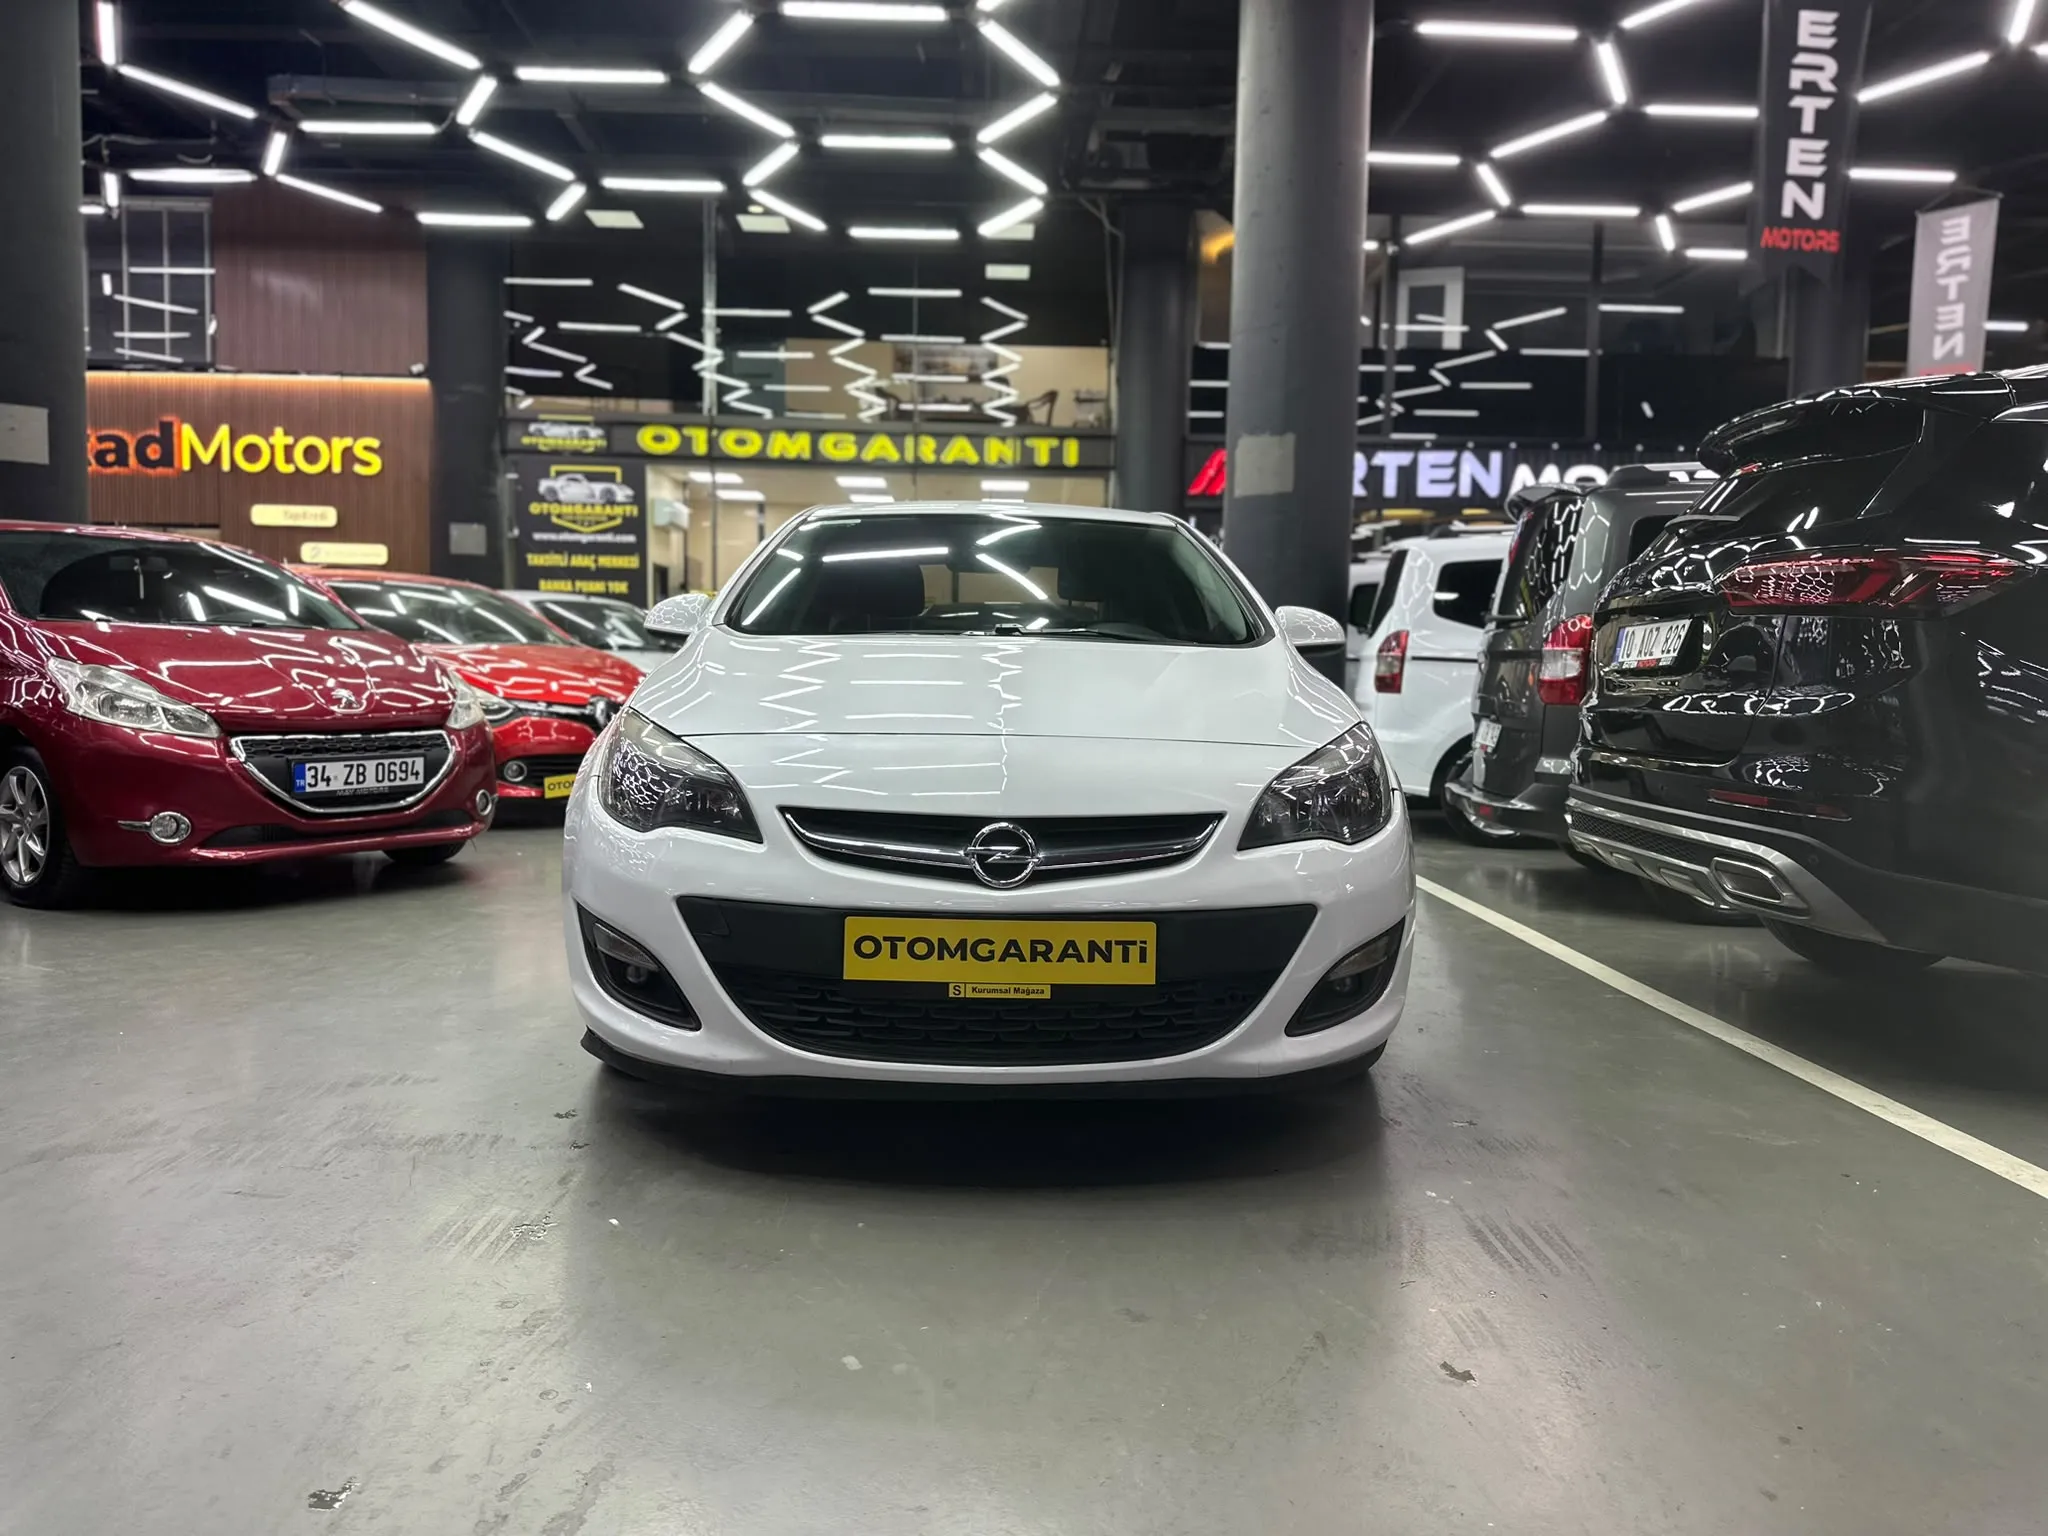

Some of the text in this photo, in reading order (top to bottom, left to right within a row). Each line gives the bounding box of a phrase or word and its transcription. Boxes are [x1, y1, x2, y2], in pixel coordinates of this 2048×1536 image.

[1780, 9, 1840, 220] ERTEN
[1760, 226, 1841, 253] MOTORS
[87, 417, 382, 476] adMotors
[636, 424, 1080, 467] OTOMGARANTI
[307, 760, 420, 788] 34 ZB 0694
[971, 986, 1011, 995] Kurumsal
